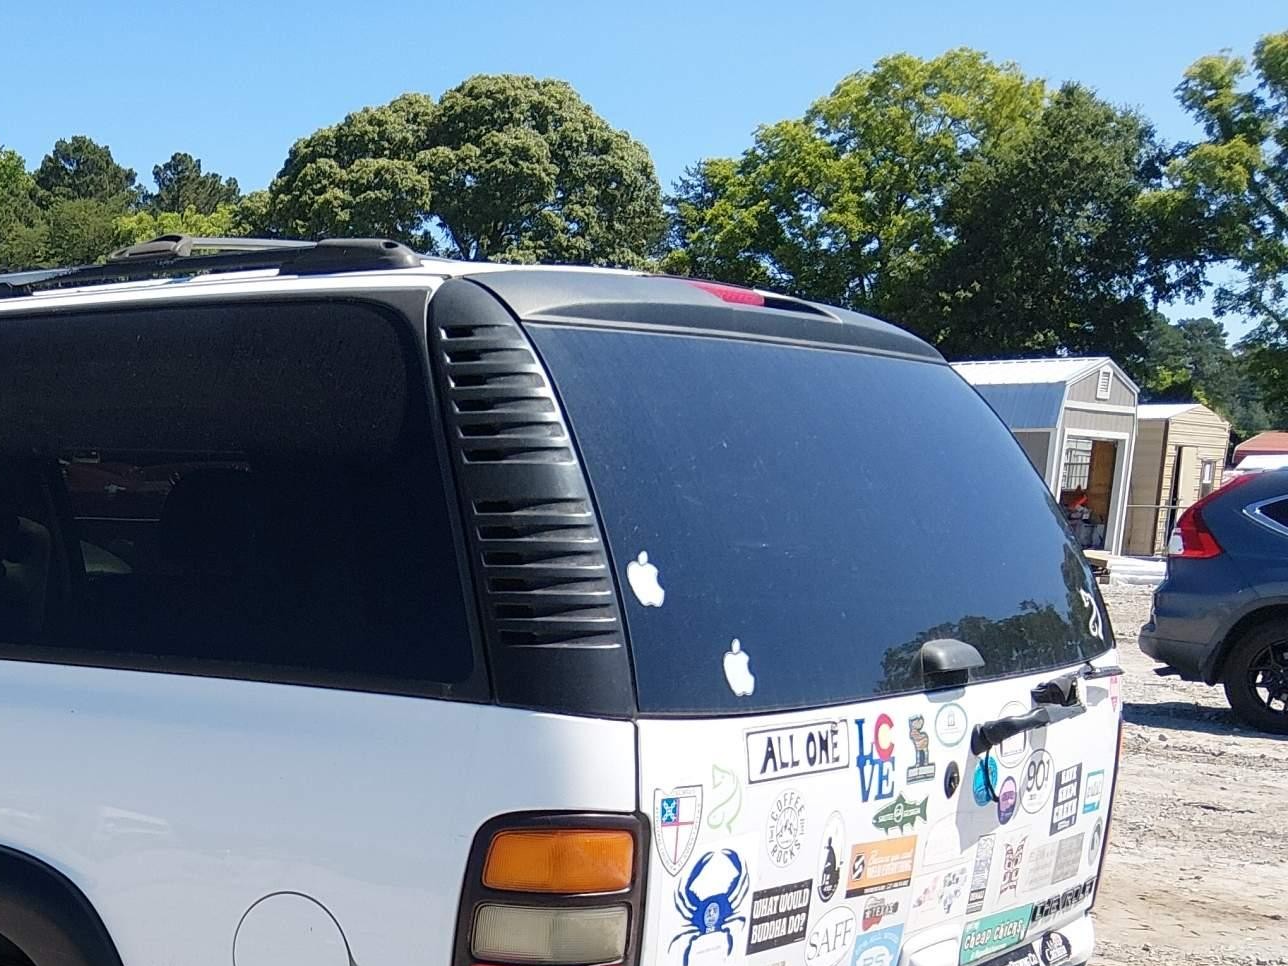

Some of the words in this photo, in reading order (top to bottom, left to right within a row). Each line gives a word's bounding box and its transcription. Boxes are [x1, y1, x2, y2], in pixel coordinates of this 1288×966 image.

[760, 733, 800, 775] ALL
[806, 725, 840, 767] ONE
[1027, 759, 1050, 792] 901
[771, 791, 805, 822] COFFEE
[771, 839, 801, 864] ROCKS
[752, 894, 780, 919] WHAT
[779, 888, 809, 912] WOULD
[751, 918, 787, 944] BUDDHA
[788, 912, 806, 933] DO?
[808, 918, 854, 960] SAFF
